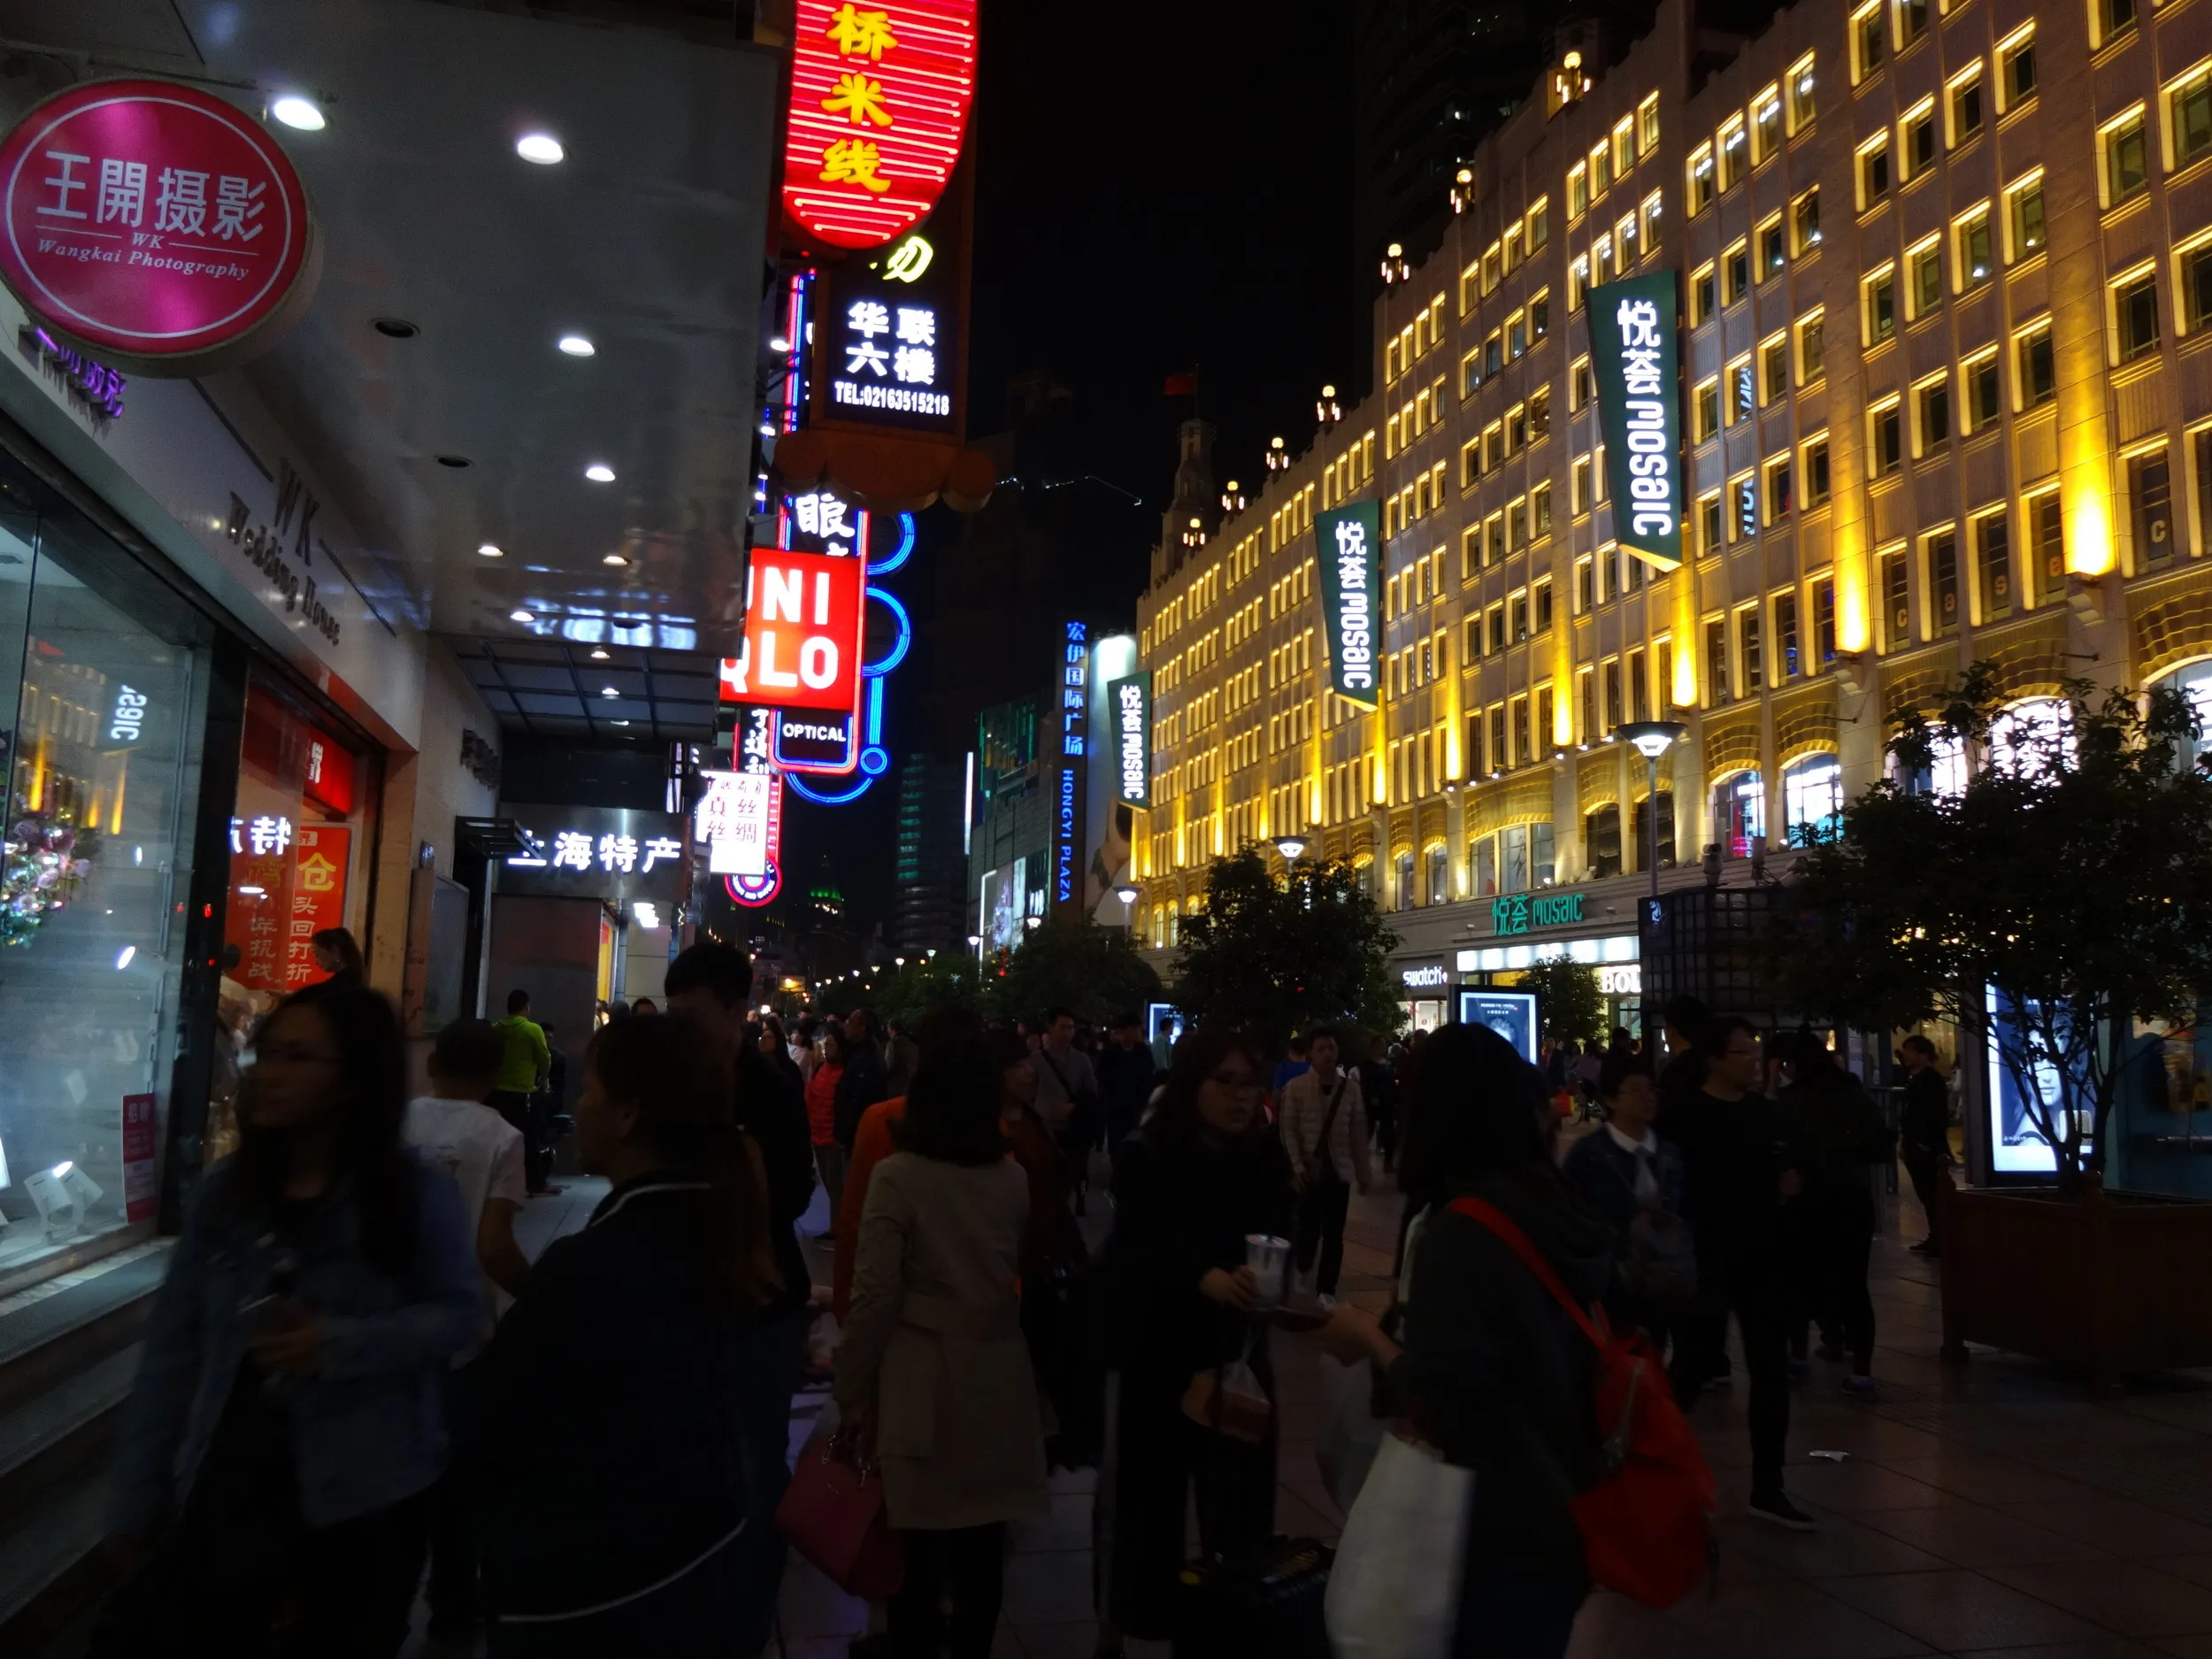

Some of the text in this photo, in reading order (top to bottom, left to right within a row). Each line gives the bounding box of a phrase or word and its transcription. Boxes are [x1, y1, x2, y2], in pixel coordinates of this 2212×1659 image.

[818, 3, 899, 193] 桥米线
[36, 150, 266, 242] 王開摄影
[39, 238, 249, 280] Wangkai Photography
[133, 232, 165, 249] WK
[848, 302, 935, 346] 华联
[1617, 299, 1662, 395] 悦荟
[834, 381, 949, 416] TEL:02163515218
[274, 457, 320, 566] WK
[795, 493, 856, 556] 眼
[1335, 520, 1367, 589] 悦荟
[747, 565, 830, 625] NI
[720, 630, 839, 693] QLO
[1064, 622, 1087, 756] 宏伊国际广场
[782, 722, 847, 742] OPTICAL
[1119, 685, 1142, 735] 悦荟
[1059, 769, 1074, 902] HONGYI PLAZA
[1492, 893, 1530, 936] 悦荟
[1402, 965, 1442, 987] swatch
